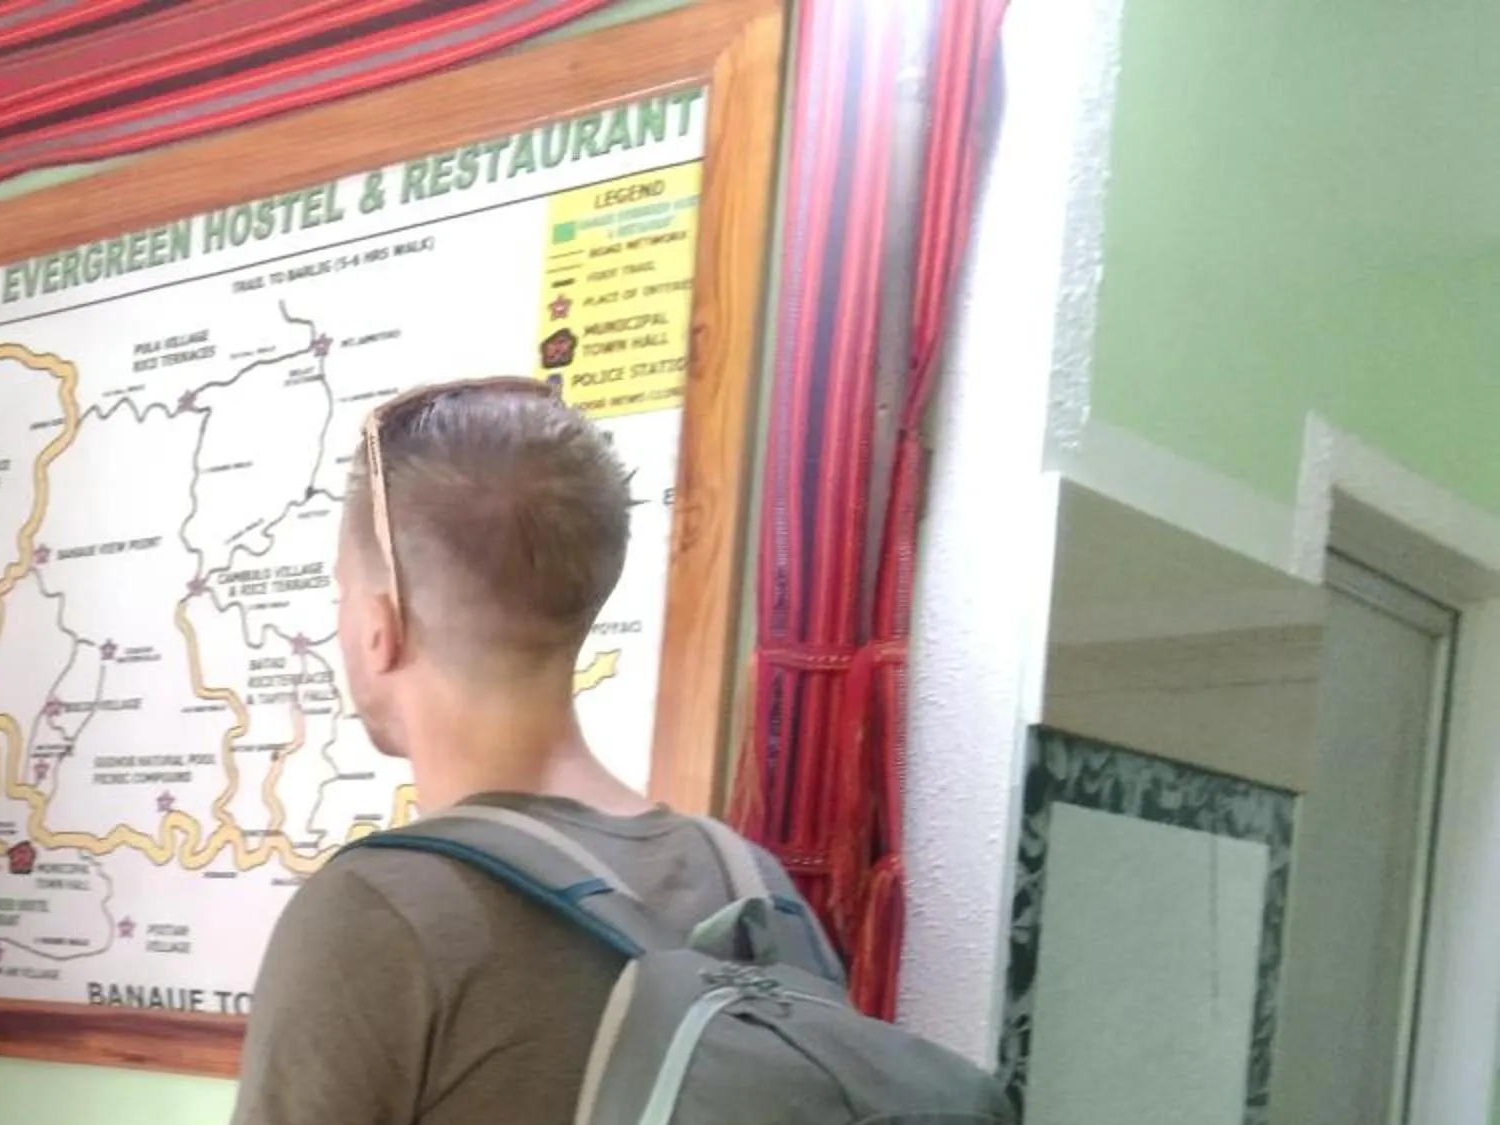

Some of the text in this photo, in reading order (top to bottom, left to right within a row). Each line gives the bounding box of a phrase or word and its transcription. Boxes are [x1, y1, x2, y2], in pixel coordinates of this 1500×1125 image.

[3, 221, 192, 301] EVERGREEN
[202, 179, 344, 255] HOSTEL
[358, 170, 387, 214] &
[400, 88, 705, 205] RESTAURANT
[593, 179, 666, 210] LEGEND
[583, 312, 669, 337] MUNICIPAL
[164, 329, 209, 349] VILLAGE
[582, 332, 669, 357] TOWN HALL
[571, 355, 689, 388] POLICE STATIO
[275, 561, 324, 578] VILLAGE
[239, 582, 268, 596] RICE
[272, 575, 331, 592] TERRACES
[87, 981, 204, 1013] BANAUE
